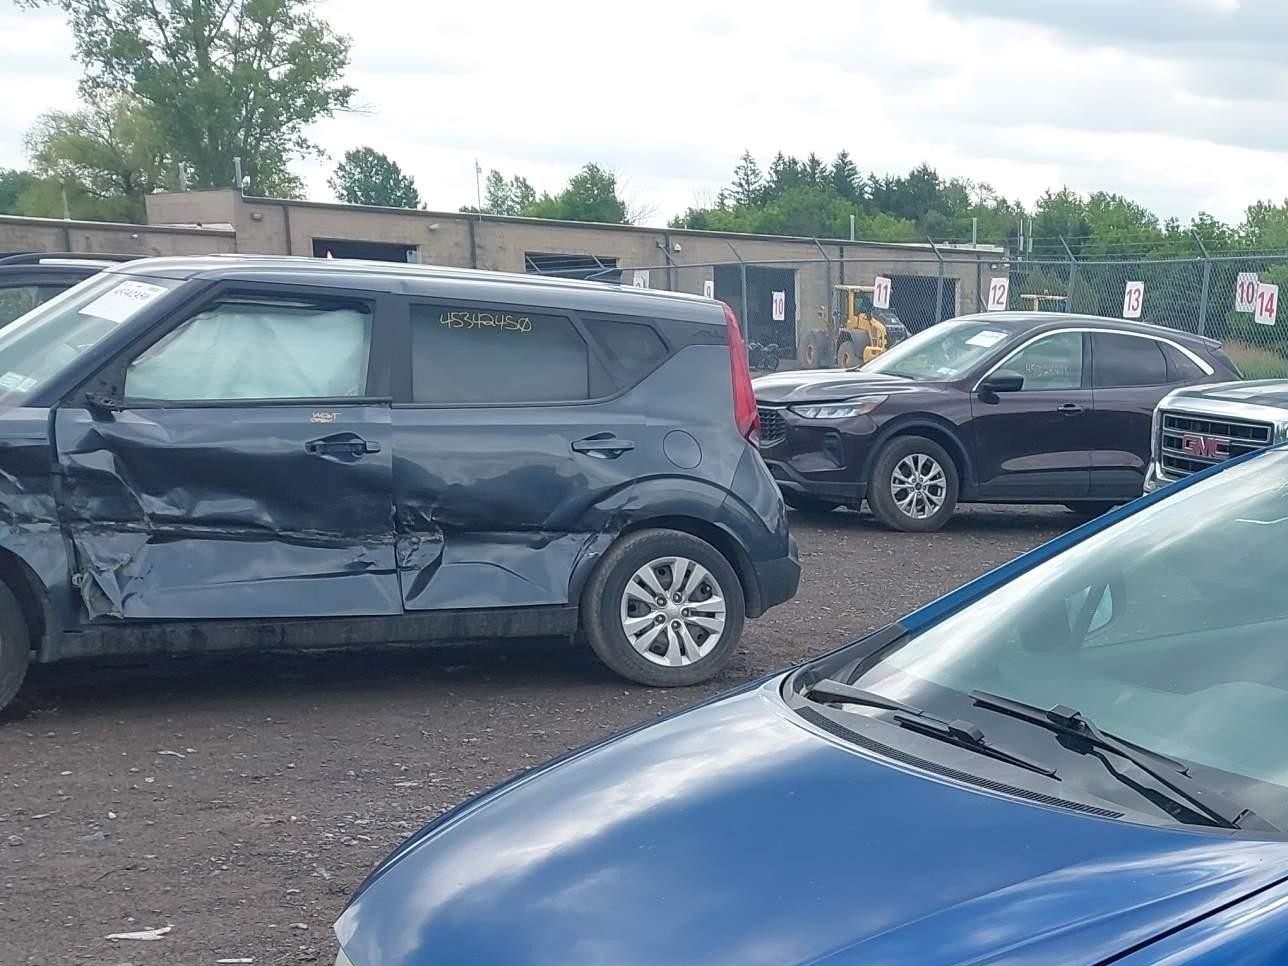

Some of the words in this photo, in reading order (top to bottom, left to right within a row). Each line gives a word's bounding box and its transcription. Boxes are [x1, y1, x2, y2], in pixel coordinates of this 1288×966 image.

[876, 282, 889, 304] 11
[992, 284, 1006, 305] 12
[1127, 288, 1141, 312] 13
[1239, 282, 1255, 305] 10
[1258, 291, 1275, 318] 14
[773, 298, 784, 316] 10
[1183, 434, 1230, 459] GMC
